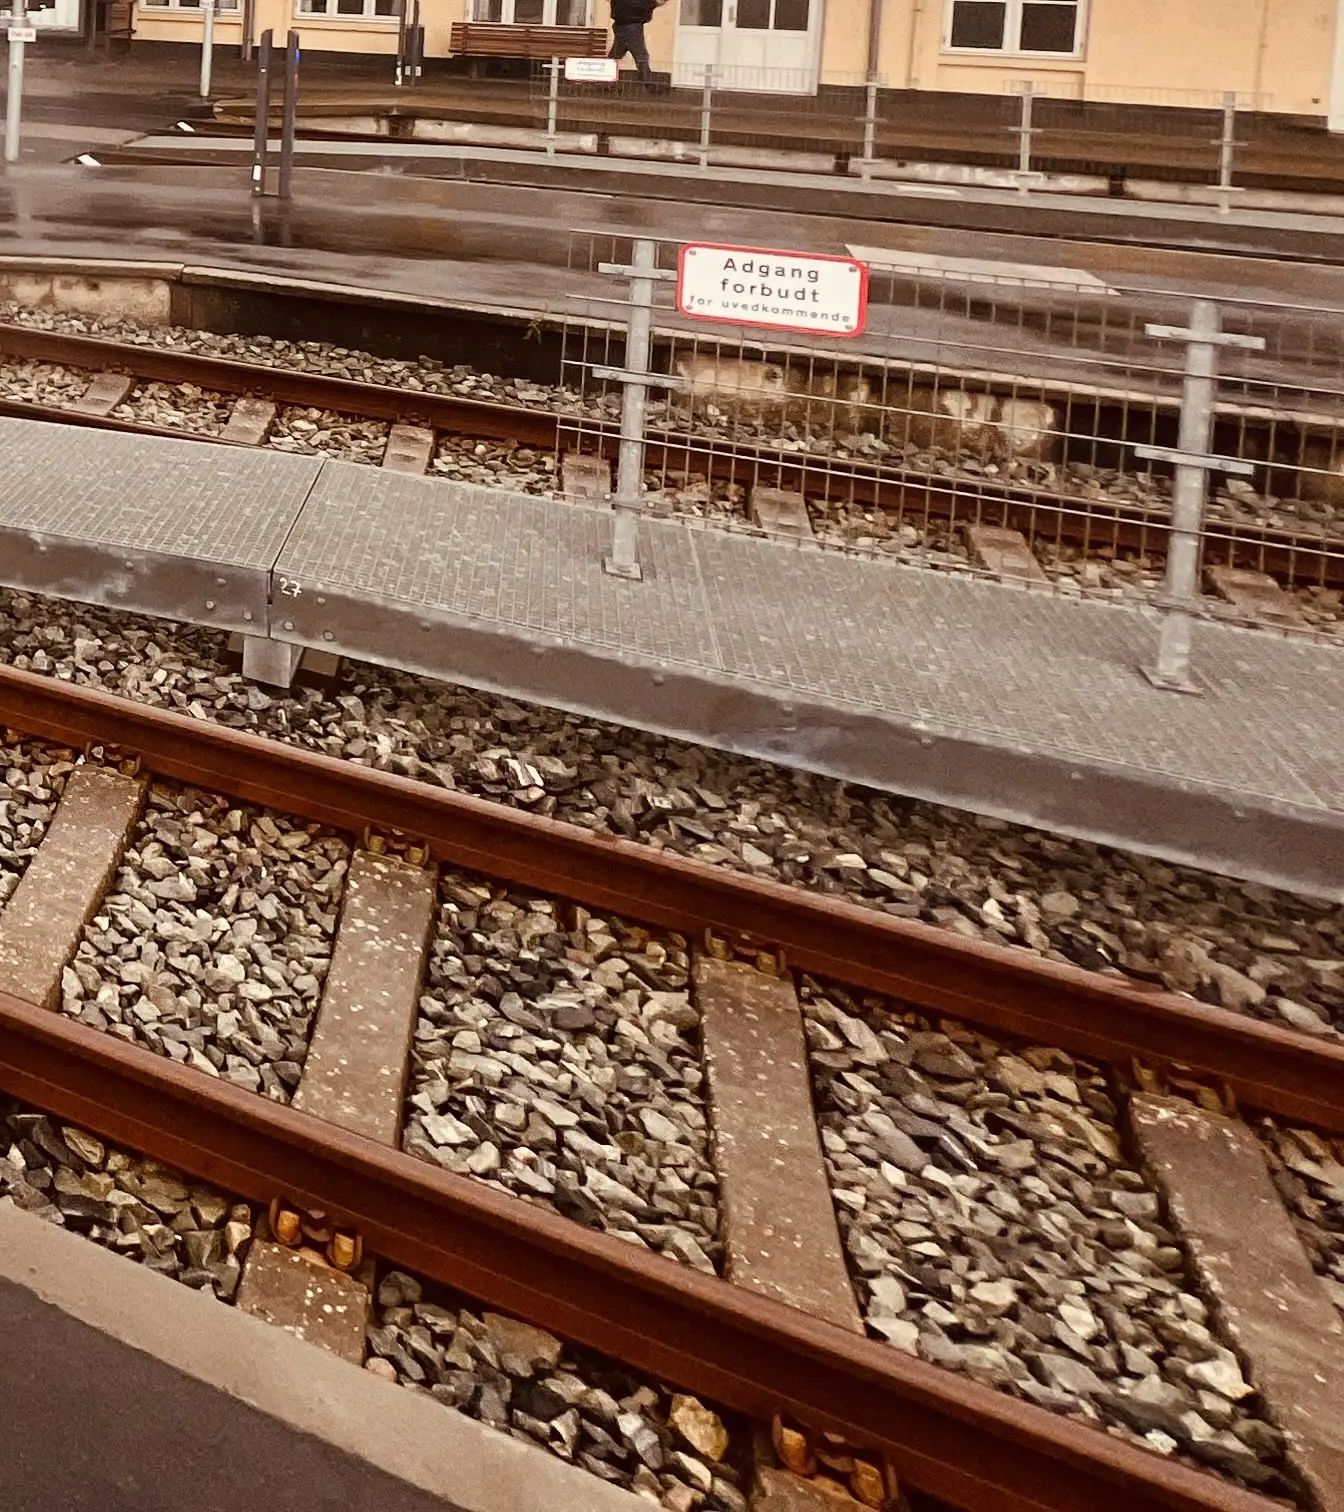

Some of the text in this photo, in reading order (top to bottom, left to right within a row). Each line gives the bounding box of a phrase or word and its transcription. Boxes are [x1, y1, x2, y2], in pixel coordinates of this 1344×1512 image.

[723, 257, 819, 283] Adgang
[721, 278, 820, 303] forbudt
[690, 295, 851, 323] for uvedkommende
